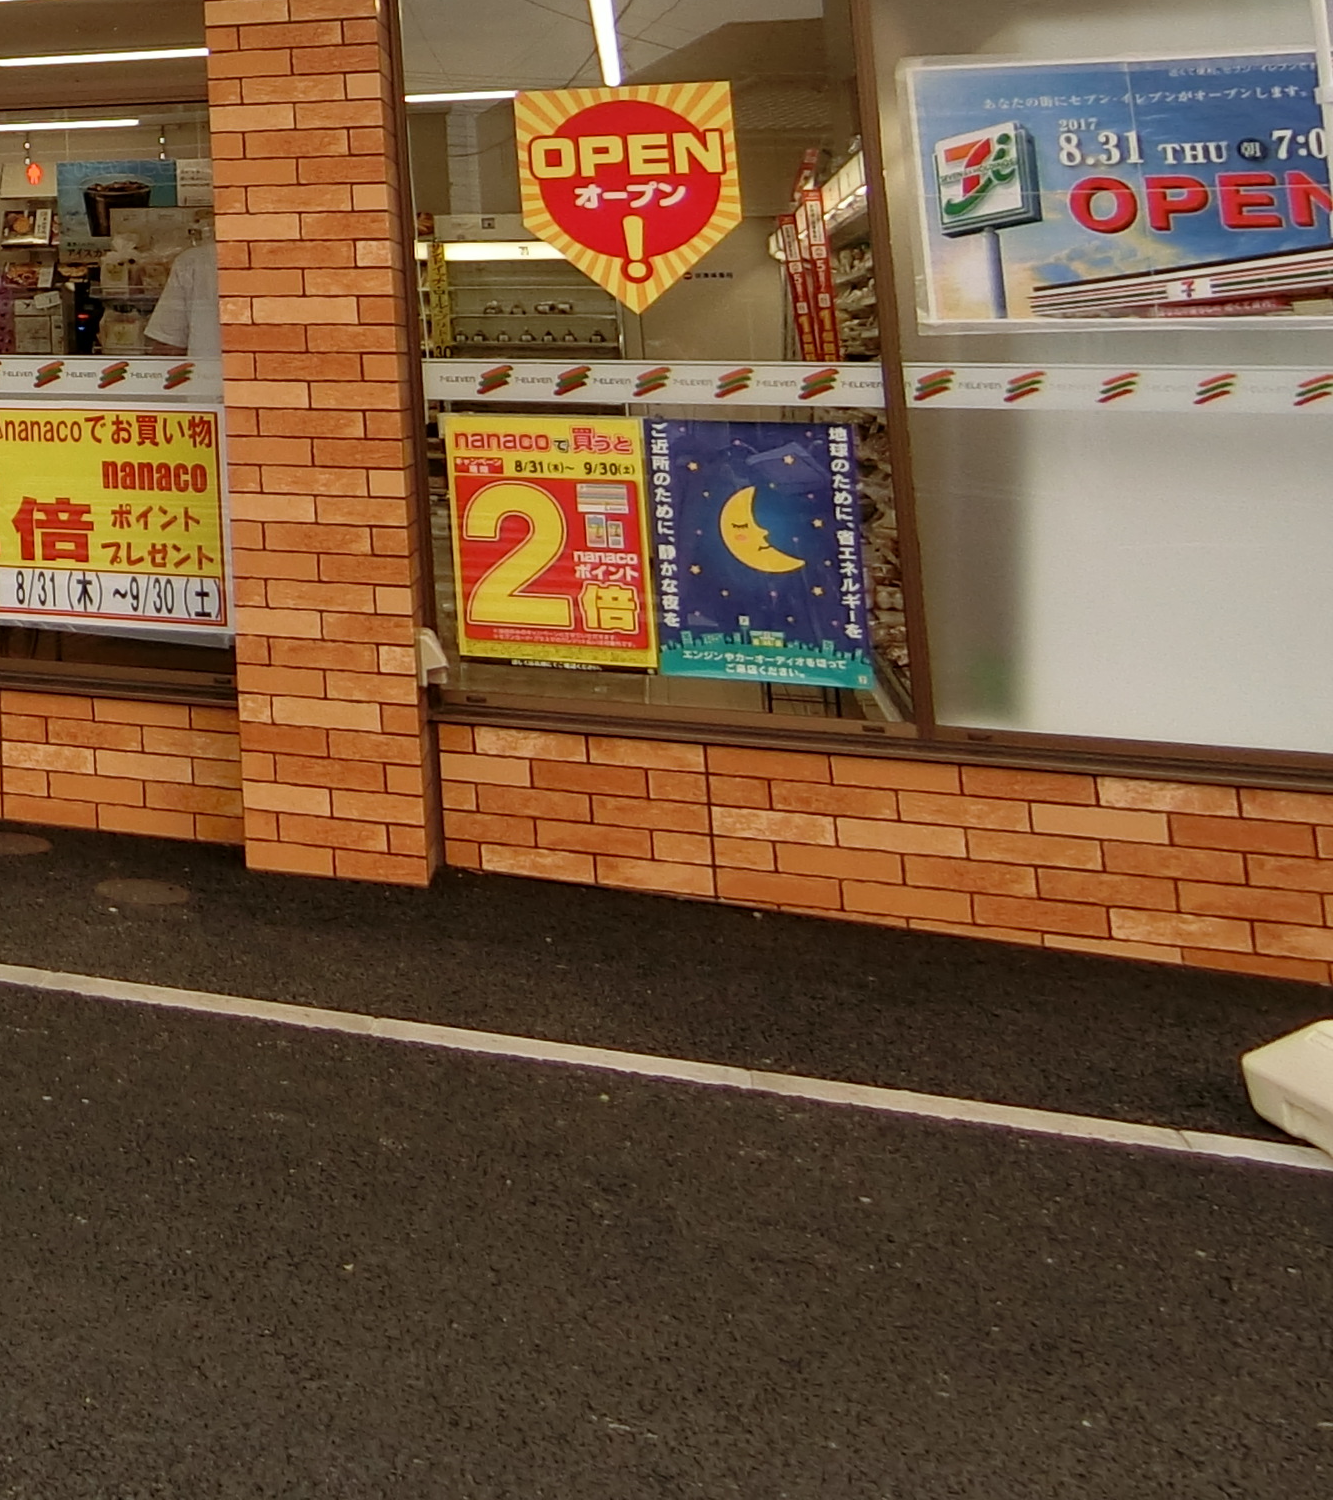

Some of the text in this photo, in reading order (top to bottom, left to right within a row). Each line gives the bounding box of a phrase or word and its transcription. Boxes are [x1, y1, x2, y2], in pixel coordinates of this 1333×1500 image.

[1058, 117, 1098, 133] 2017
[530, 128, 725, 180] OPEN
[1058, 129, 1144, 167] 8.31
[1157, 141, 1229, 165] THU
[1271, 127, 1327, 160] 7:0
[574, 181, 686, 209] オープン
[4, 414, 212, 449] nanacoでお買い物
[454, 427, 633, 455] nanacoで買うと
[101, 460, 208, 493] nanaco
[111, 502, 201, 532] ポイント
[650, 422, 681, 628] ご近所のために、静かな夜を
[828, 426, 863, 640] 地球のために、省エネルギーを
[101, 541, 214, 570] プレゼント
[463, 480, 575, 630] 2
[573, 551, 637, 565] nanaco
[575, 564, 638, 581] ポイント
[578, 580, 639, 634] 倍
